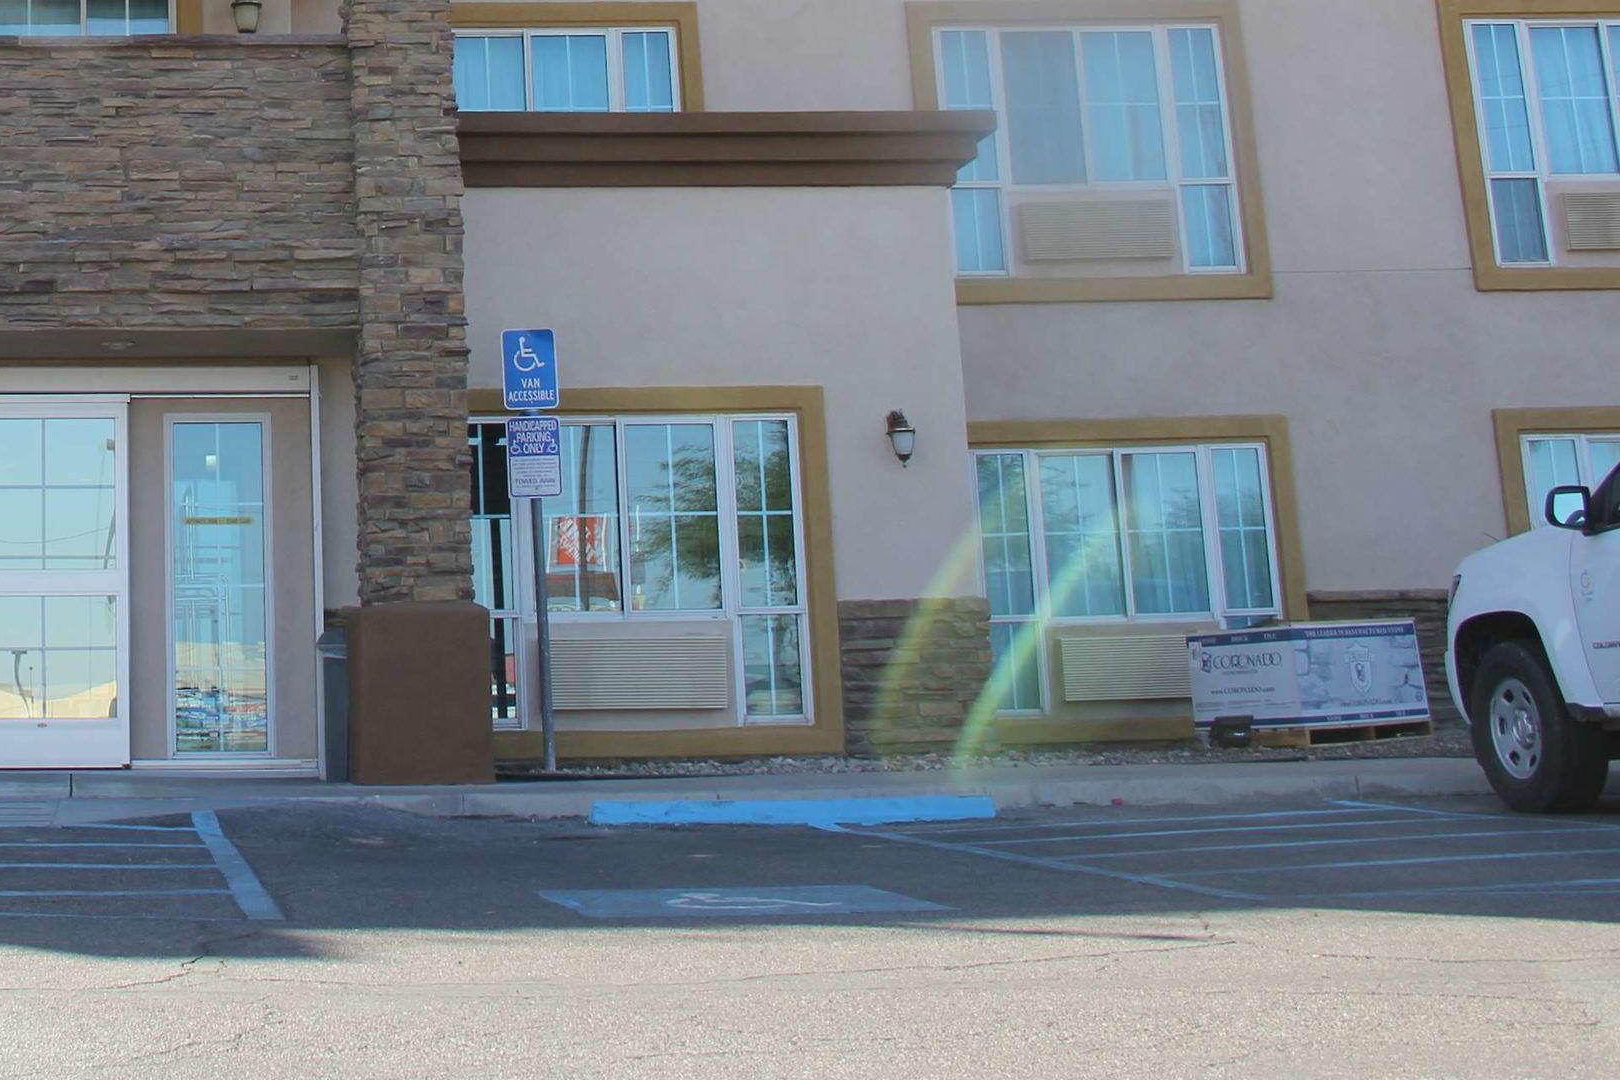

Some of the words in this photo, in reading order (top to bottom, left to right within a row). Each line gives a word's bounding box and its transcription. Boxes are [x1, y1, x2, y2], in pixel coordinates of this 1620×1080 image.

[521, 377, 541, 389] VAN
[508, 390, 555, 401] ACCESSIBLE
[509, 420, 557, 431] HANDICAPPED
[516, 431, 551, 443] PARKING
[523, 443, 545, 453] ONLY
[1212, 652, 1281, 669] CORONADO
